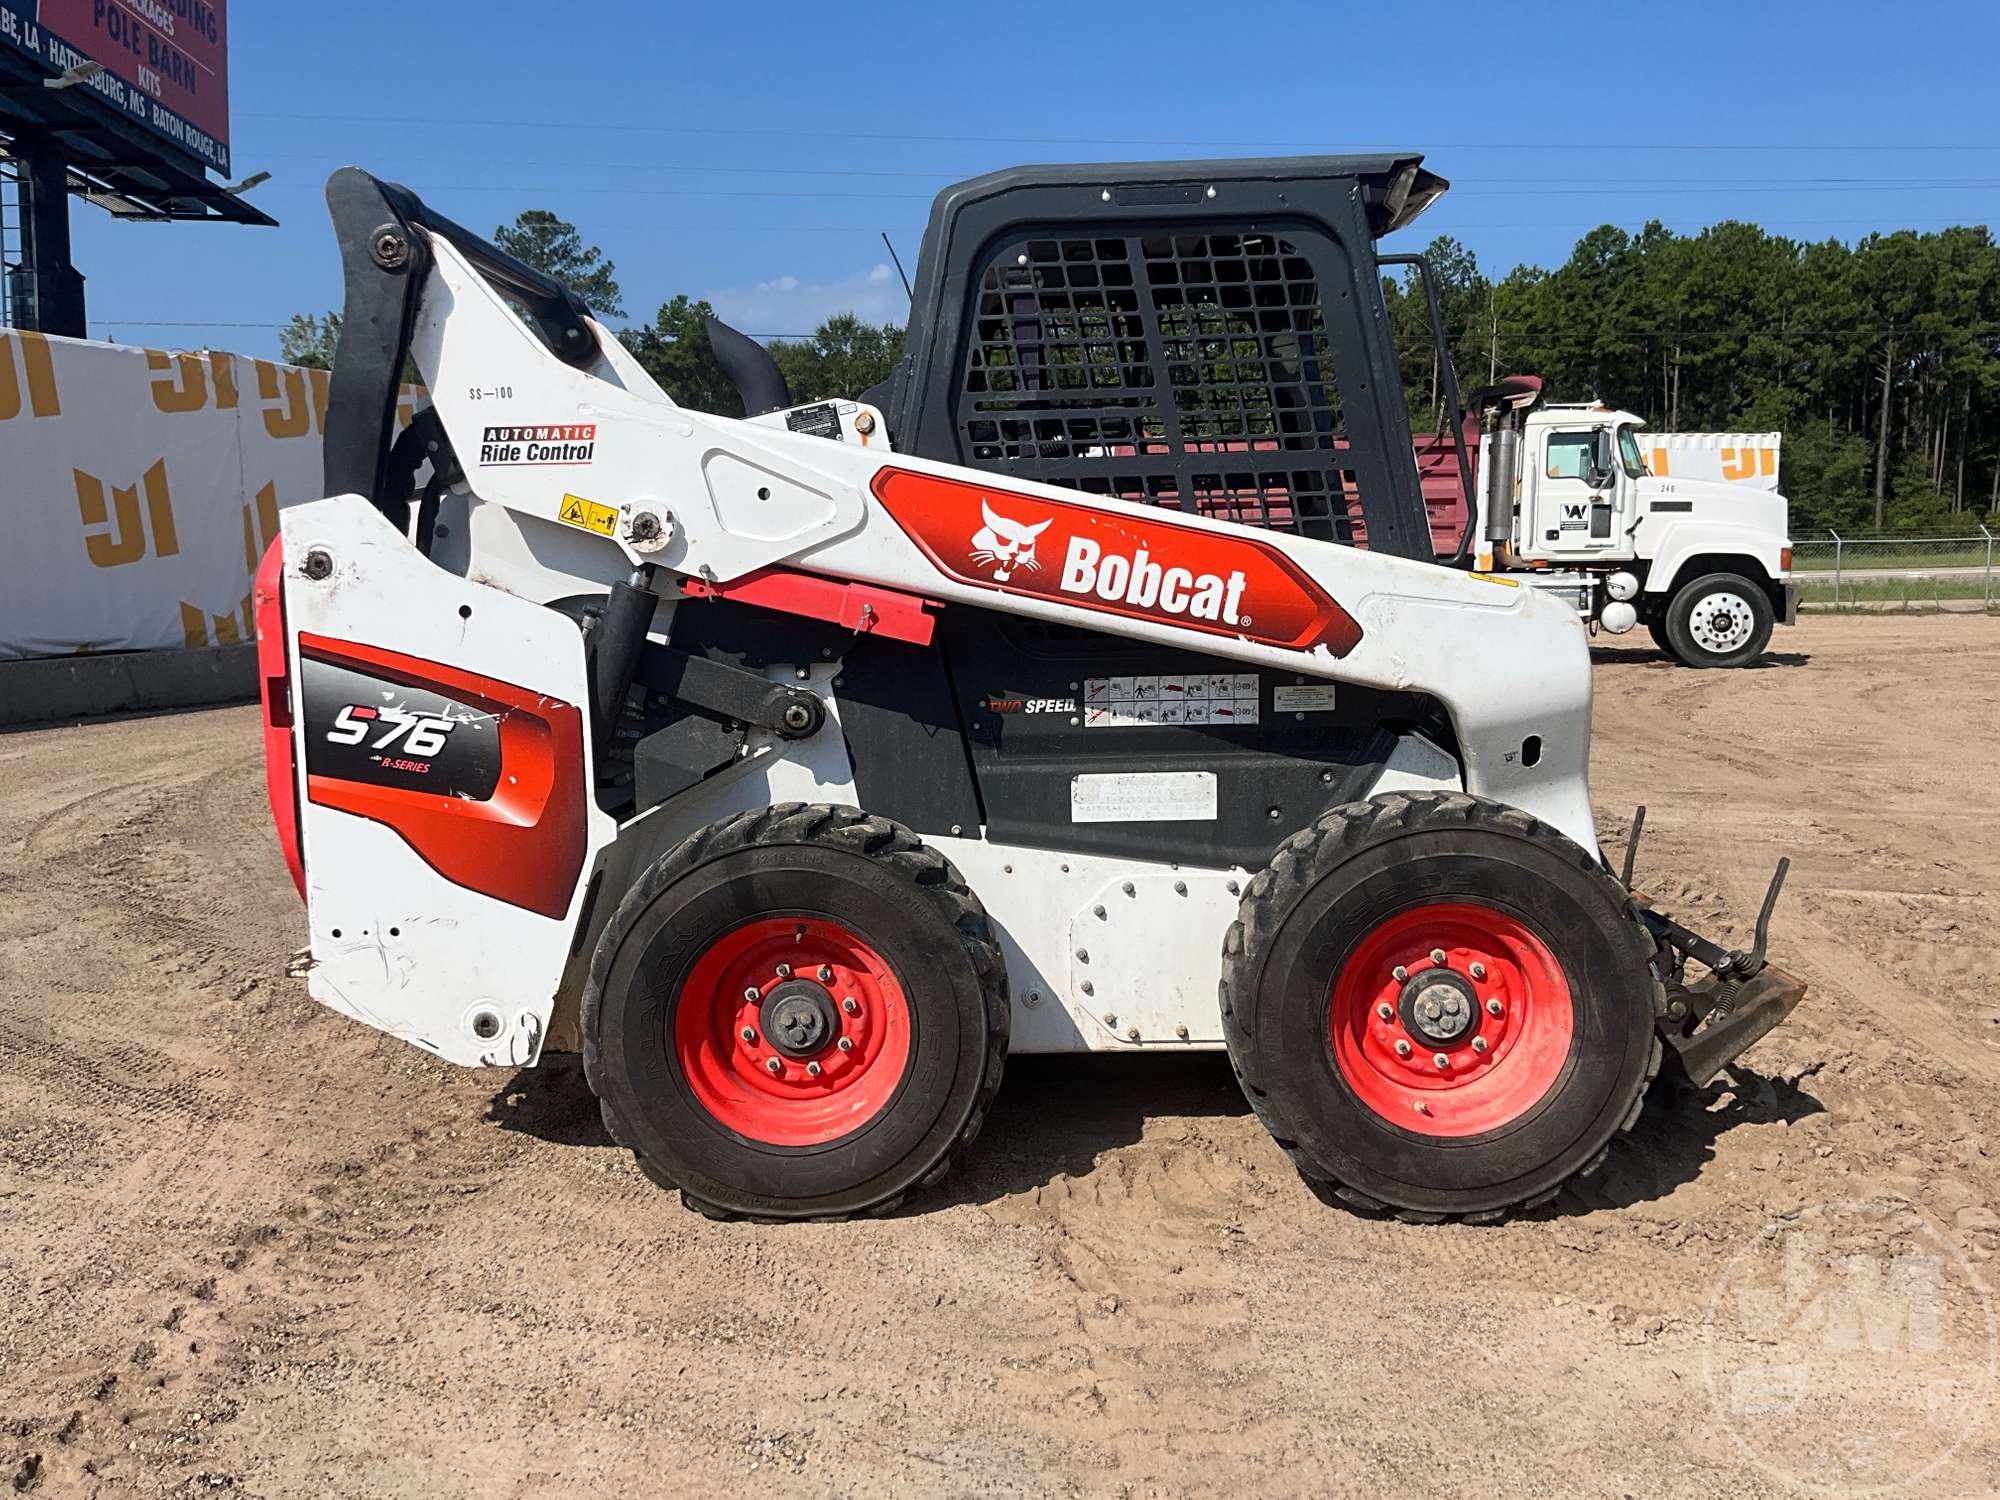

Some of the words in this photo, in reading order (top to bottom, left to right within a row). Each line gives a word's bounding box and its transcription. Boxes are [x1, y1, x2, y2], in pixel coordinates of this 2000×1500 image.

[148, 33, 196, 95] BARN
[138, 64, 161, 97] KITS
[24, 21, 41, 54] LA
[129, 89, 146, 118] MS
[152, 103, 184, 141] BATON
[184, 124, 217, 164] ROUGE,
[217, 145, 228, 168] LA
[469, 386, 513, 400] SS-100
[486, 427, 592, 441] AUTOMATIC
[480, 444, 521, 462] Ride
[527, 443, 594, 460] Control
[1060, 536, 1246, 626] Bobcat
[990, 700, 1022, 712] TWO
[327, 705, 455, 758] S76
[381, 757, 431, 773] R-SERIES
